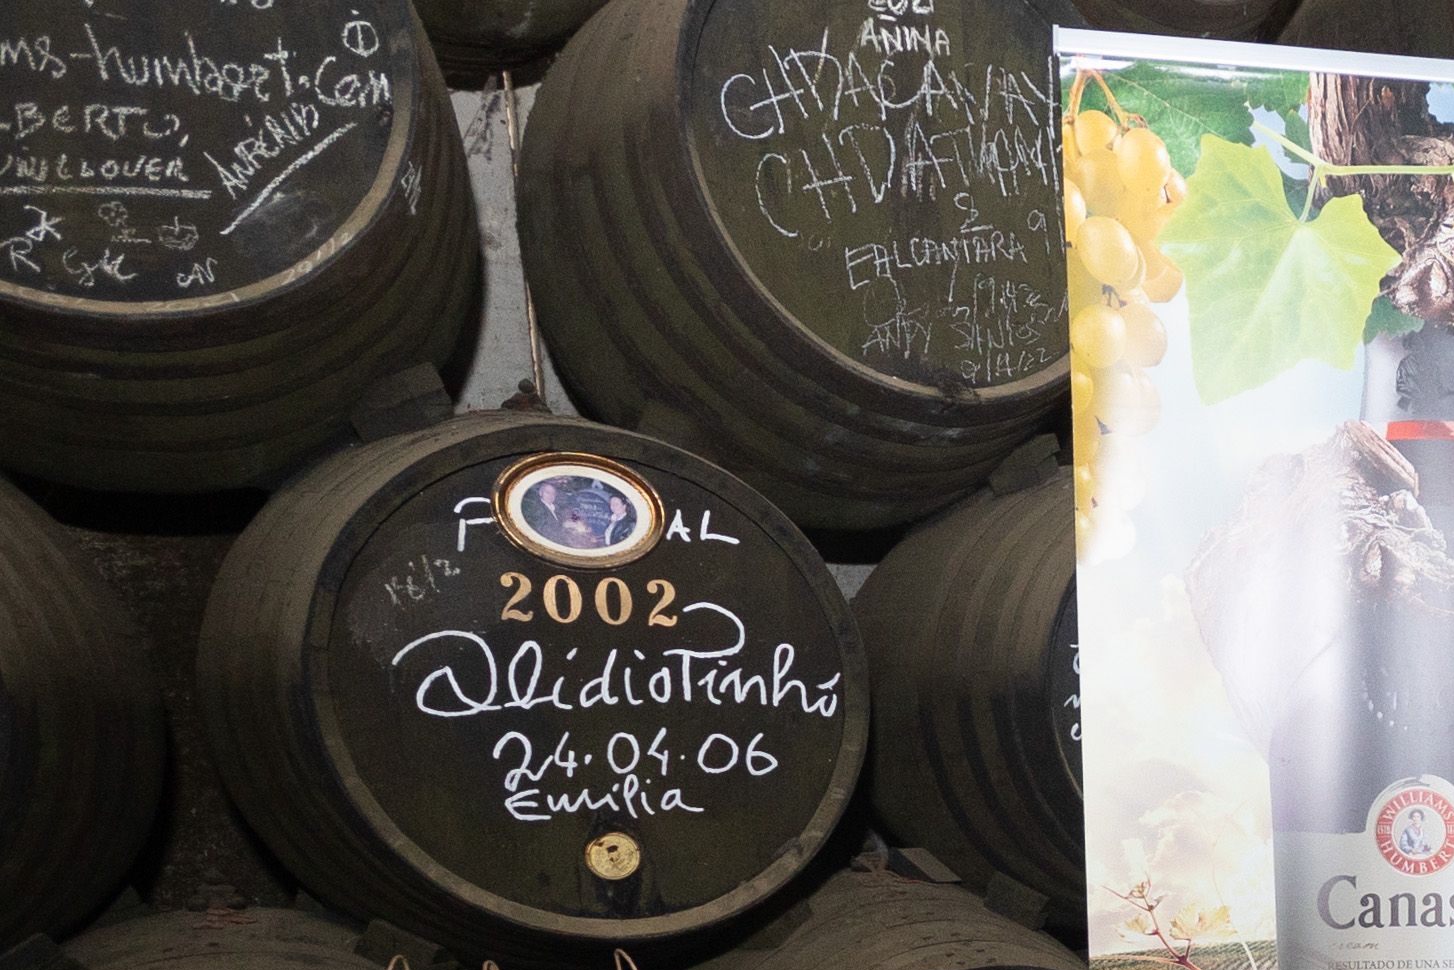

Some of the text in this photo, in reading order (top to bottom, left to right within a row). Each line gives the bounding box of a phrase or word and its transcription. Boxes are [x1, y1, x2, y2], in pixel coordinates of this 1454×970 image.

[500, 572, 679, 626] 2002
[493, 727, 779, 791] 24.04.06
[505, 773, 704, 822] Emilia
[1328, 959, 1395, 970] RESULTADO
[1397, 959, 1414, 970] DE
[1415, 958, 1441, 969] UNA
